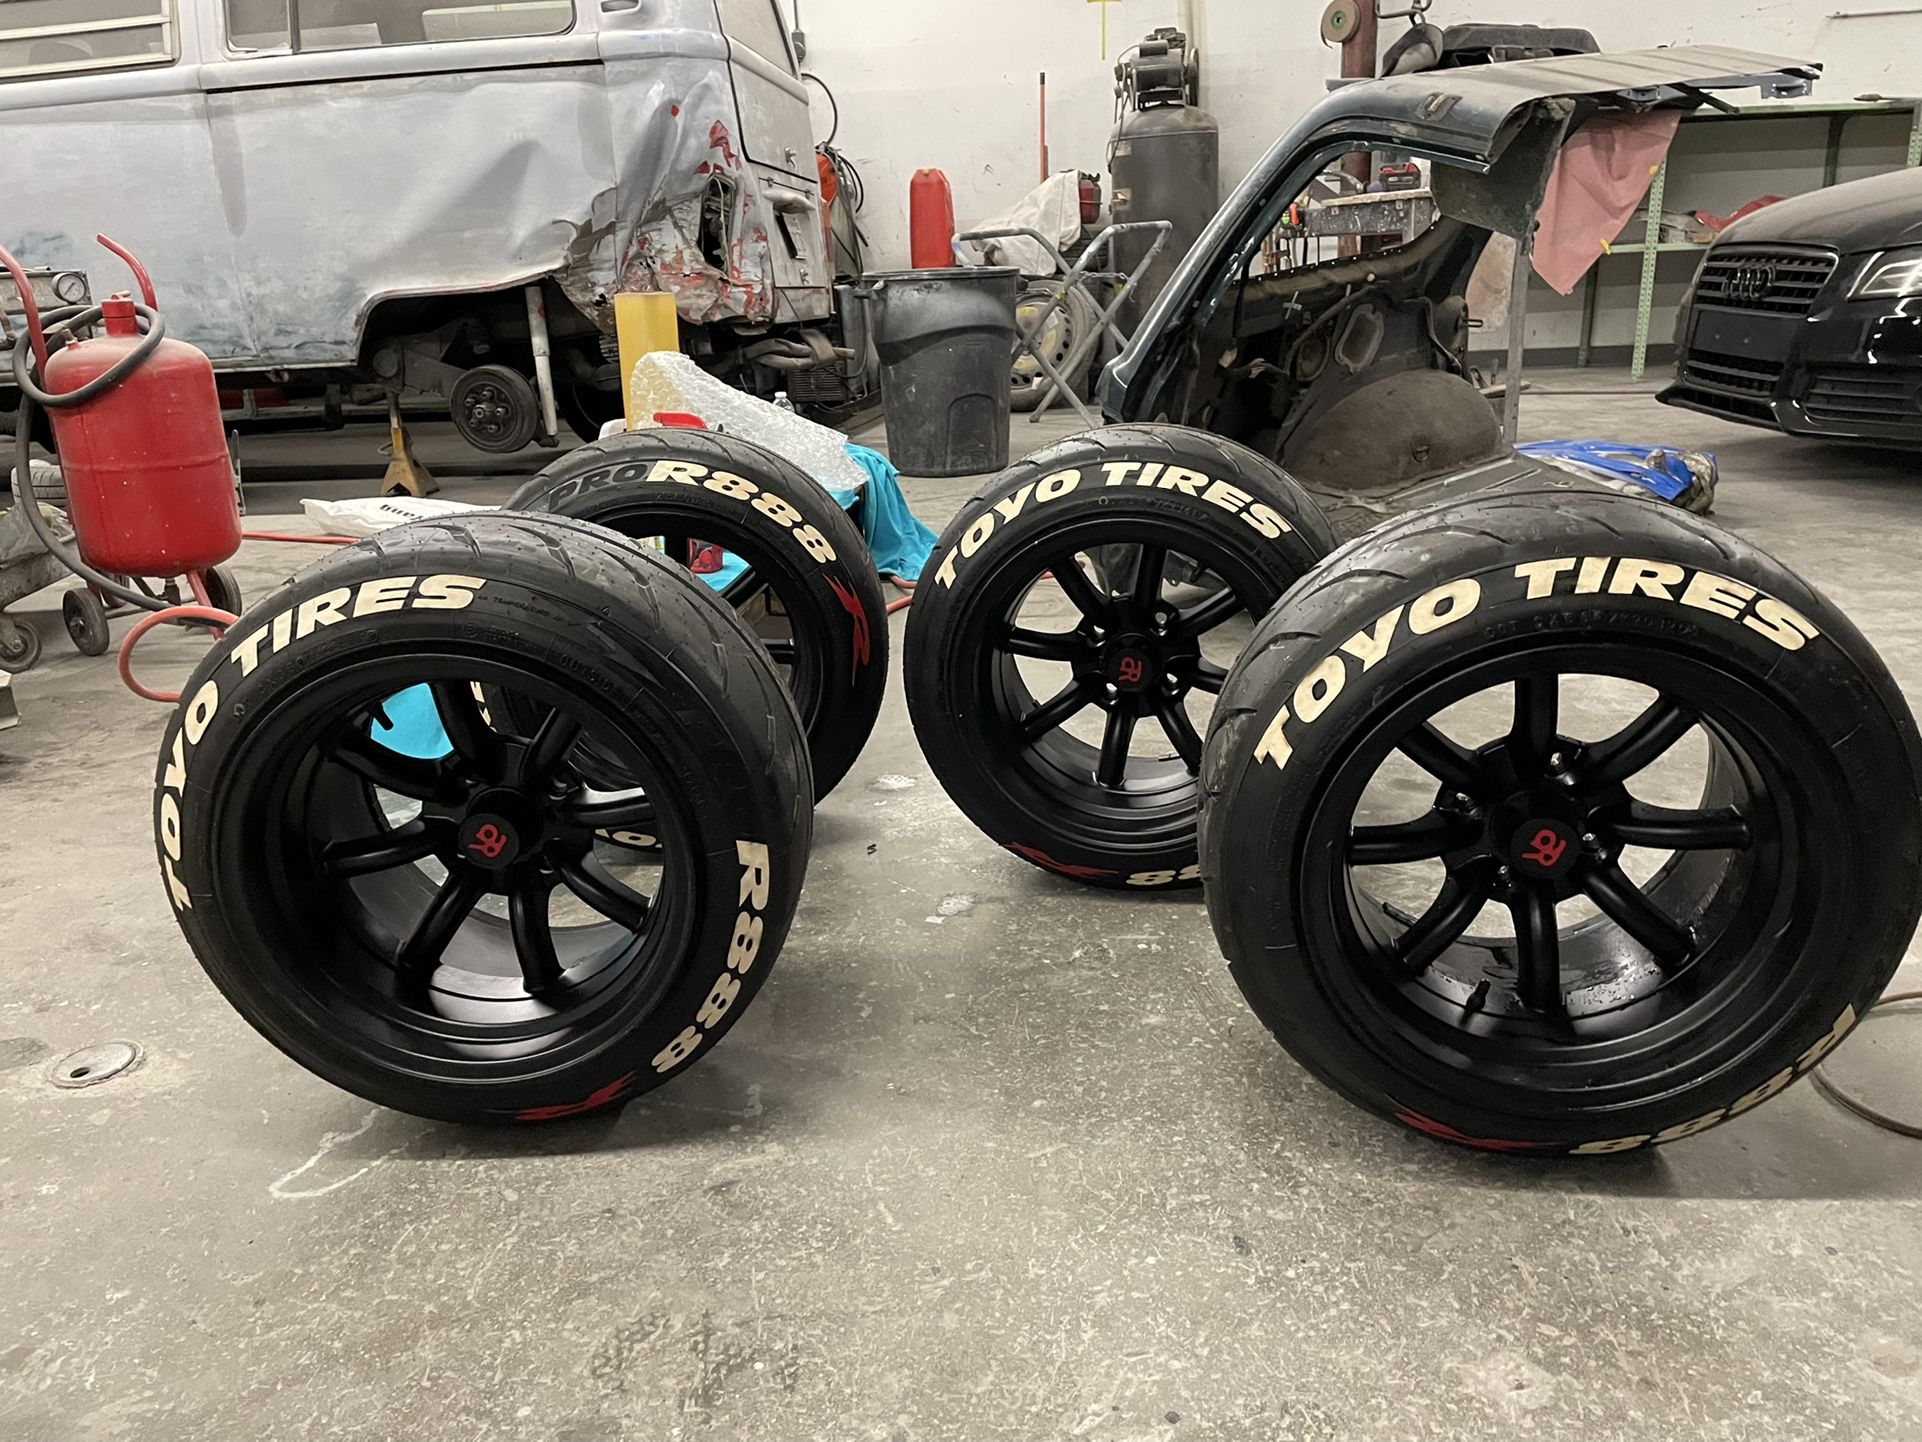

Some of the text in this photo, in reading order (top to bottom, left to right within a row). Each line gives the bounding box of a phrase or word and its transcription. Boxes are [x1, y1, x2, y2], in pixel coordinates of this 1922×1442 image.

[934, 461, 1293, 590] TOYO TIRES
[160, 680, 219, 911] TOYO
[230, 574, 487, 677] TIRES
[1253, 556, 1820, 770] TOYO TIRES
[651, 840, 770, 1073] R888
